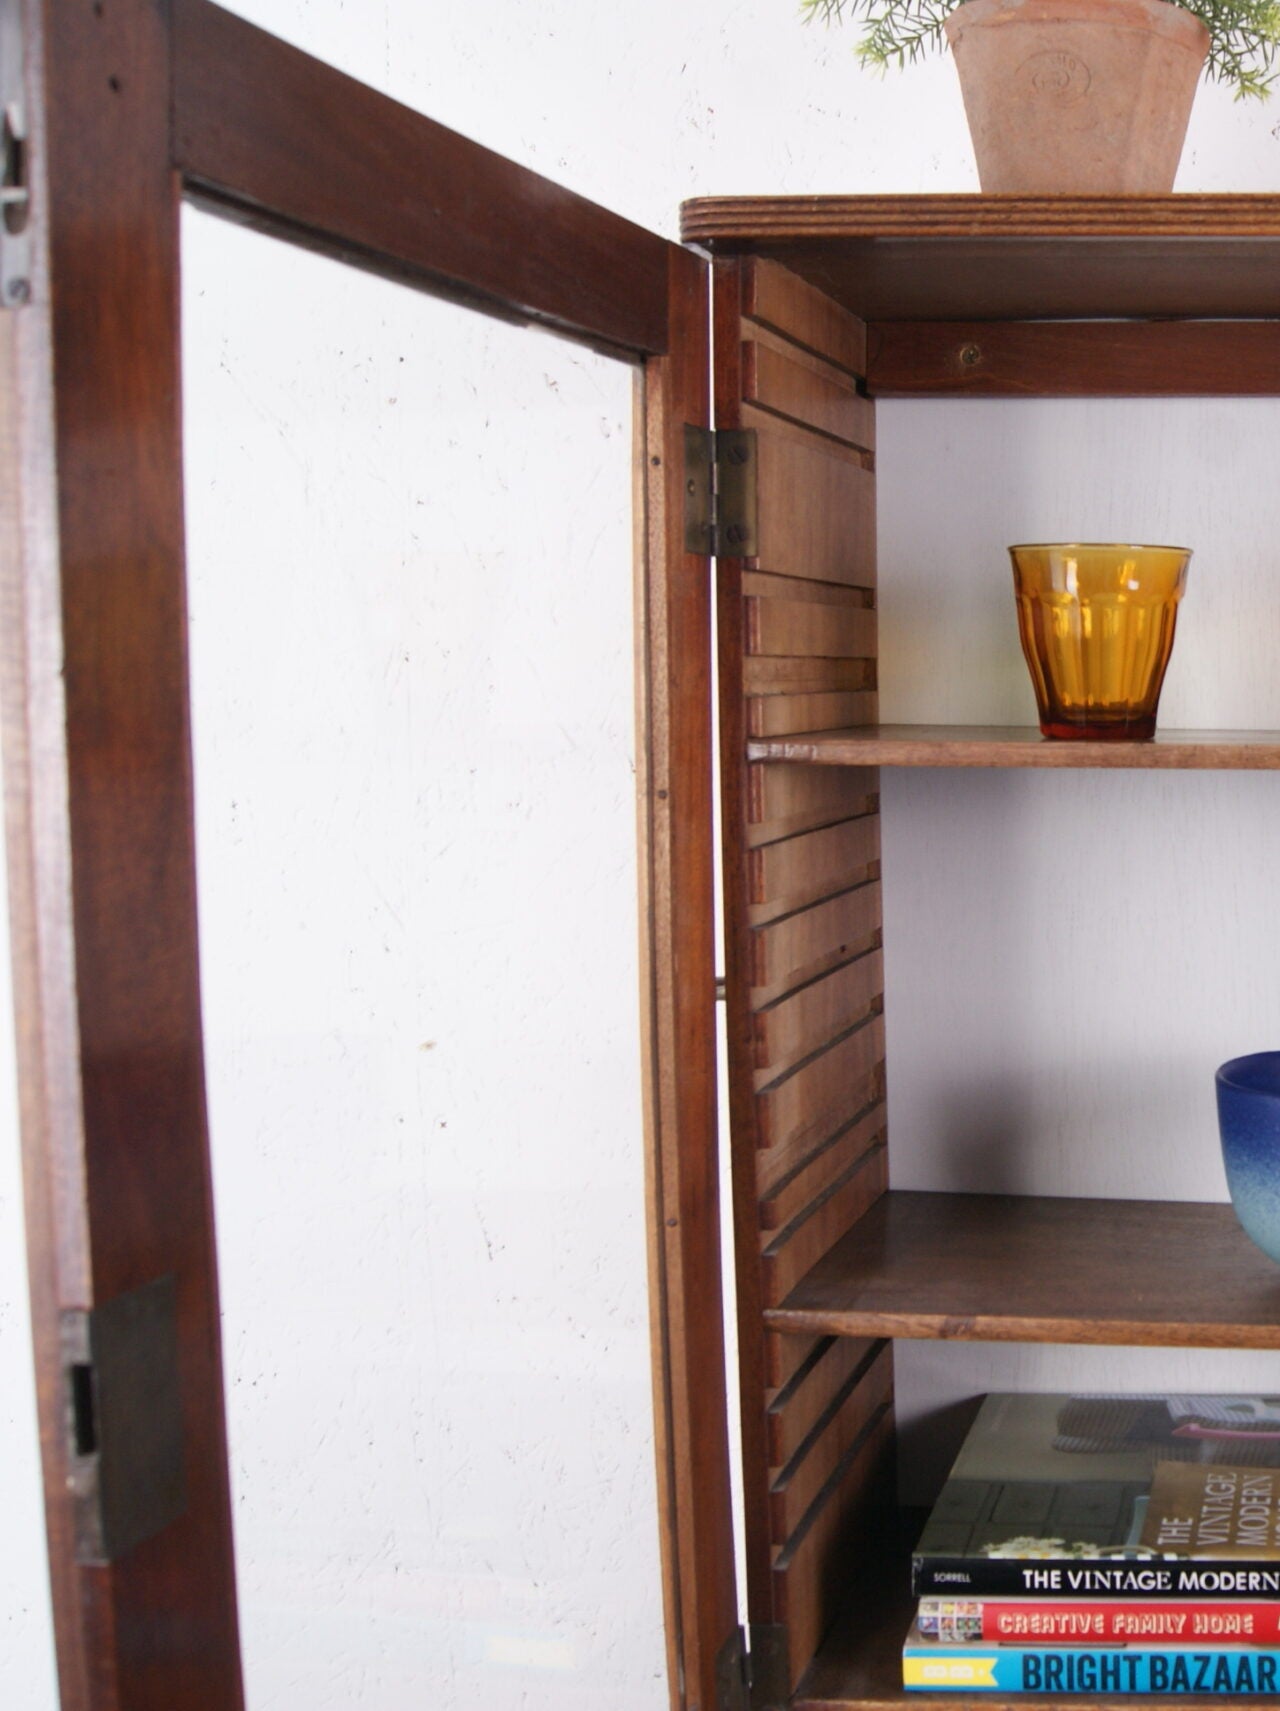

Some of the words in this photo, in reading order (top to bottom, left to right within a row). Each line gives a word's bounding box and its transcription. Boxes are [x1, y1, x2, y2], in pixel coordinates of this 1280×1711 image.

[1196, 1472, 1238, 1546] VINTAGE
[1235, 1475, 1273, 1546] MODERN
[1157, 1517, 1194, 1545] THE
[934, 1572, 971, 1583] SORRELL
[1023, 1570, 1062, 1589] THE
[1068, 1570, 1172, 1590] VINTAGE
[1178, 1571, 1280, 1591] MODERN
[998, 1612, 1104, 1634] CREATIVE
[1112, 1613, 1186, 1634] FAMILY
[1193, 1614, 1254, 1634] HOME
[1022, 1654, 1142, 1691] BRIGHT
[1151, 1654, 1277, 1691] BAZAAR
